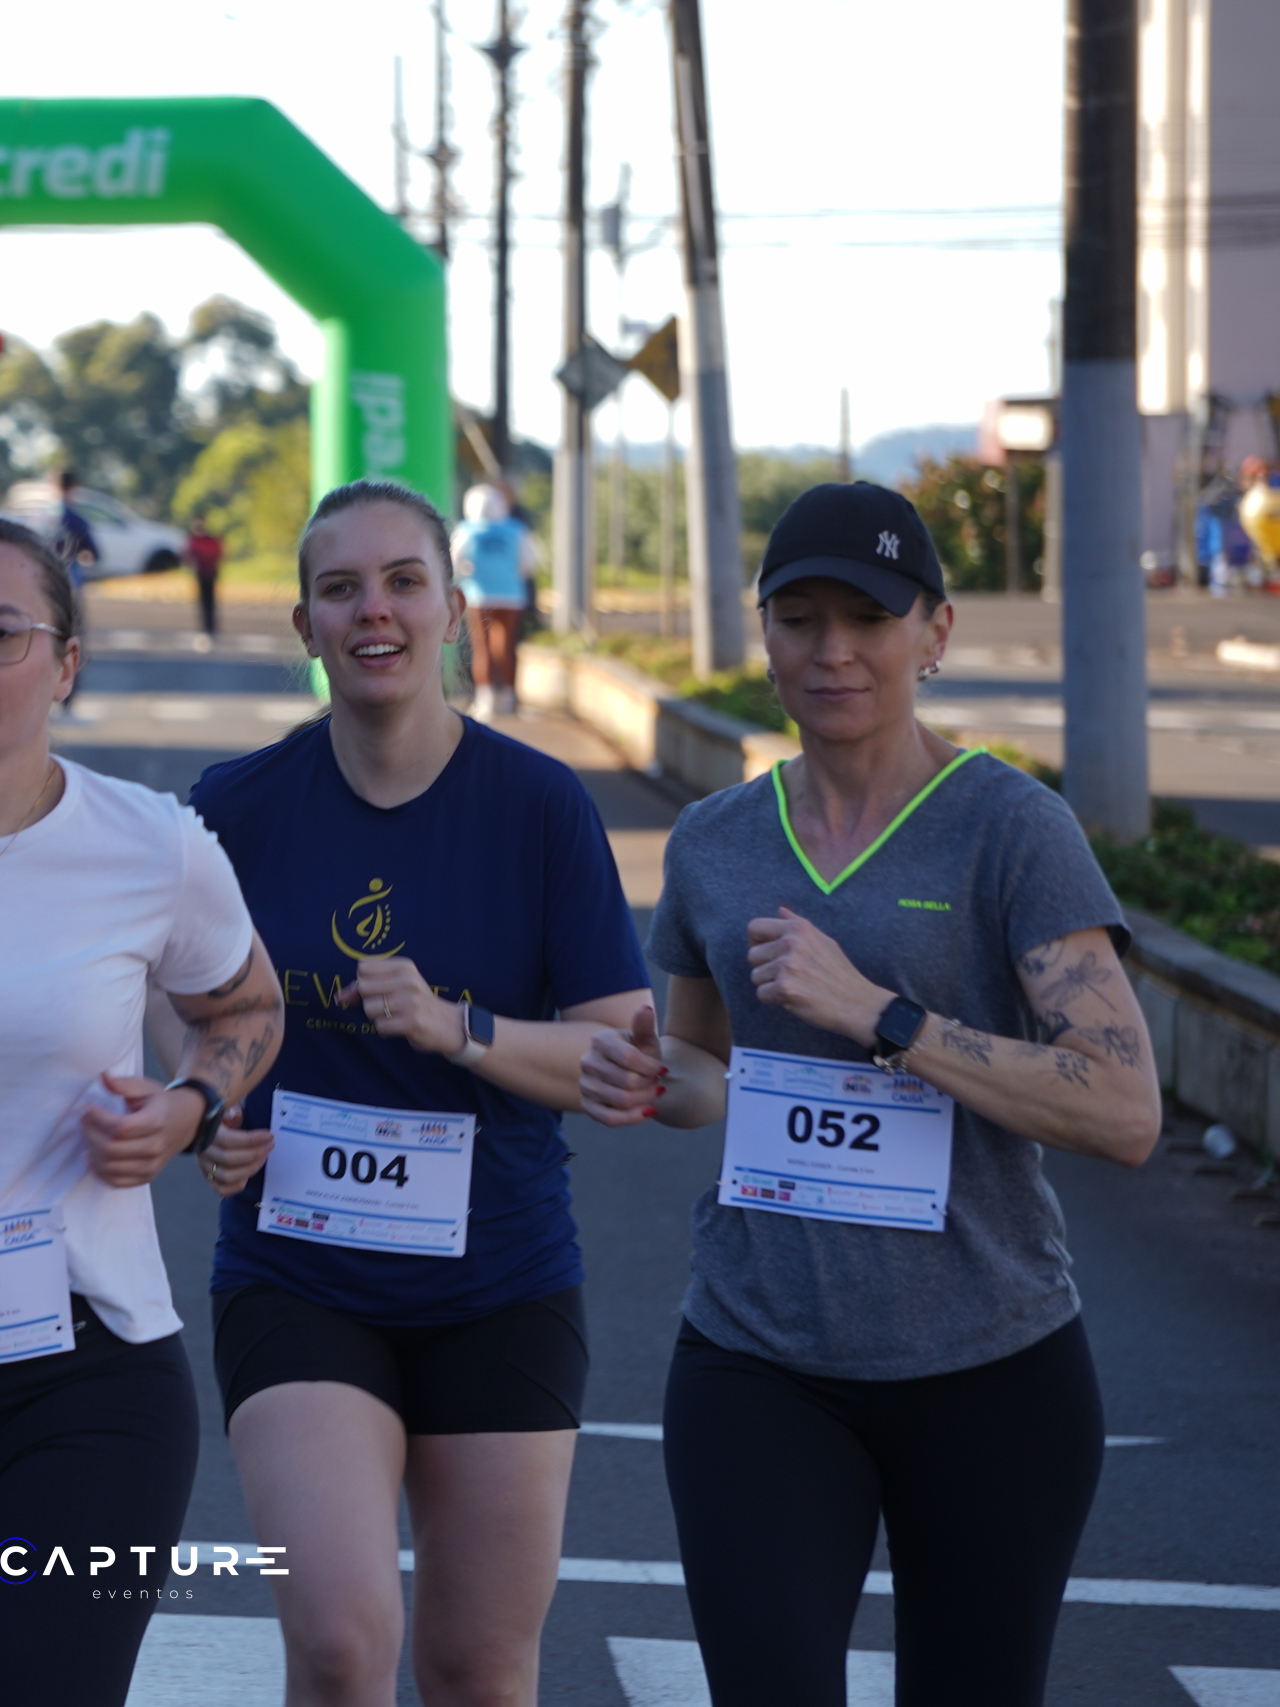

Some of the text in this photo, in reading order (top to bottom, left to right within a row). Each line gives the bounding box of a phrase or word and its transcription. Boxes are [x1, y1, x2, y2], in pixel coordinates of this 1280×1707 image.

[353, 371, 406, 480] edi
[875, 530, 900, 560] NY
[306, 1017, 356, 1034] CENTRO
[787, 1105, 881, 1152] 052
[322, 1146, 410, 1188] 004
